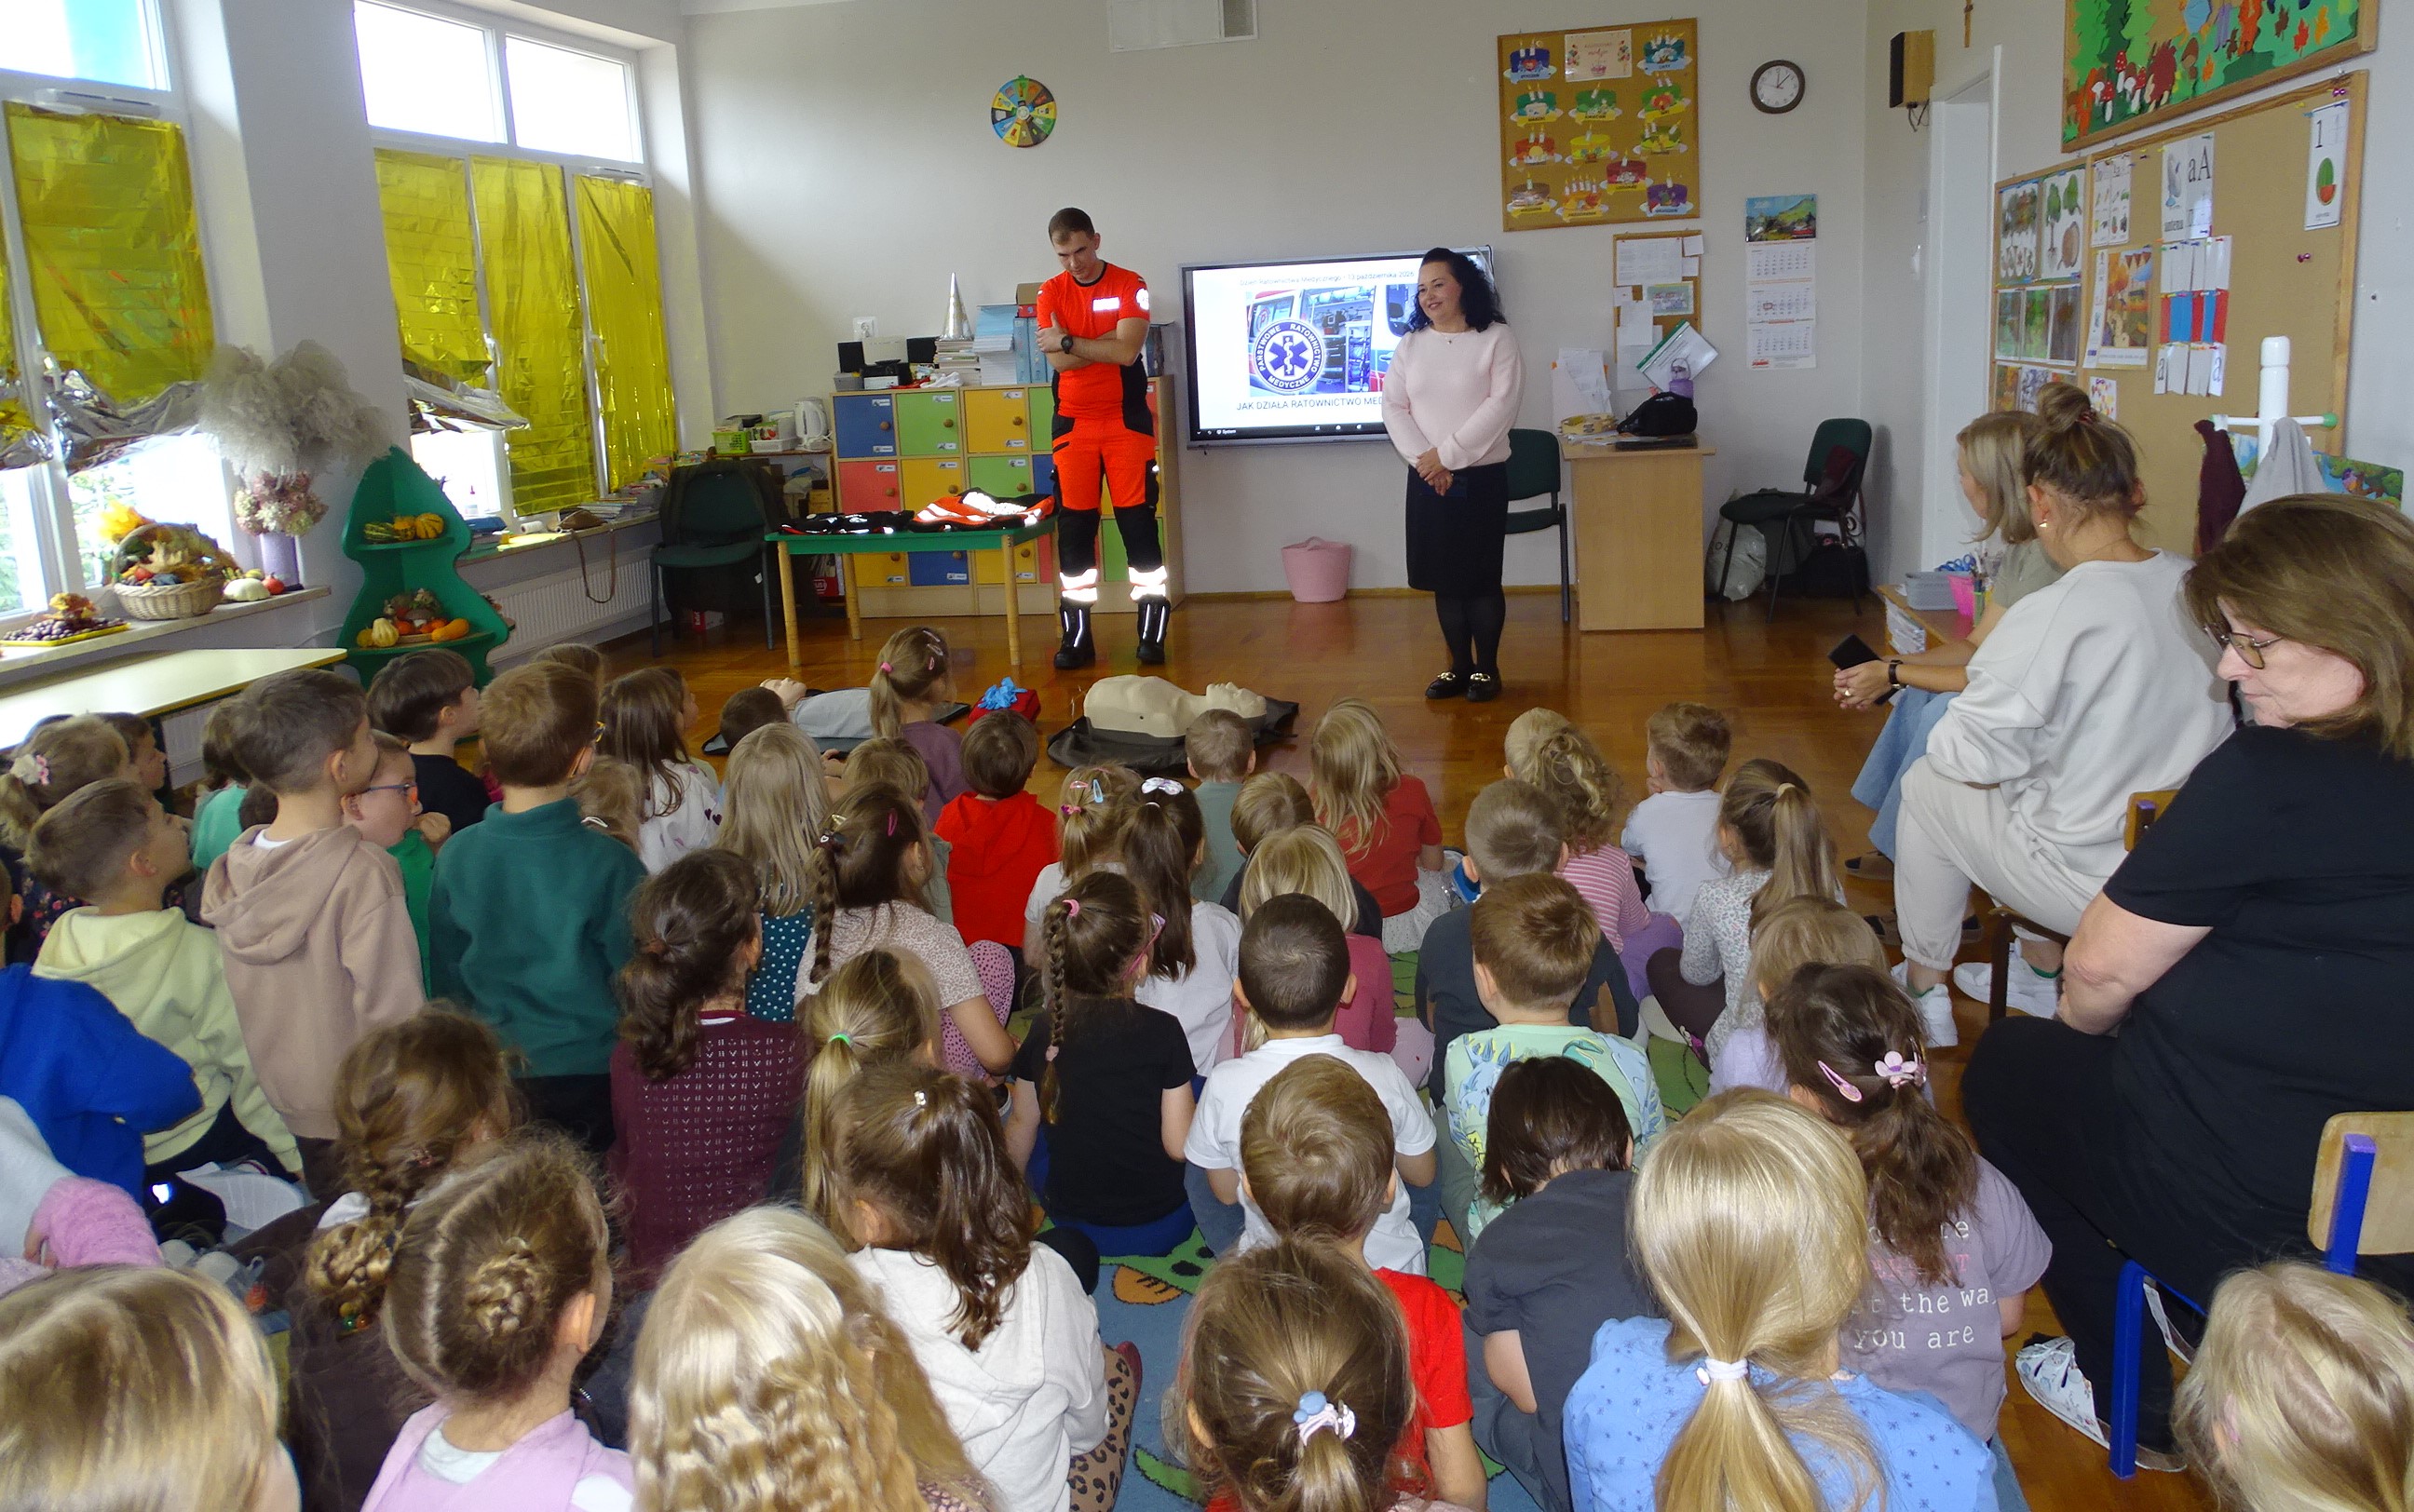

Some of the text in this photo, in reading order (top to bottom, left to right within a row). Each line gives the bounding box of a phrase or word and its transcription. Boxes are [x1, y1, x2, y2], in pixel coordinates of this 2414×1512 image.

[1256, 323, 1322, 372] PAŃSTWOWE RATOWNICTWO
[1267, 375, 1310, 388] MEDYCZNE
[1236, 396, 1383, 411] JAK DZIAŁA RATOWNICTWO MED
[1899, 1291, 1950, 1314] the
[1960, 1287, 1997, 1308] wa
[1927, 1325, 1974, 1349] are
